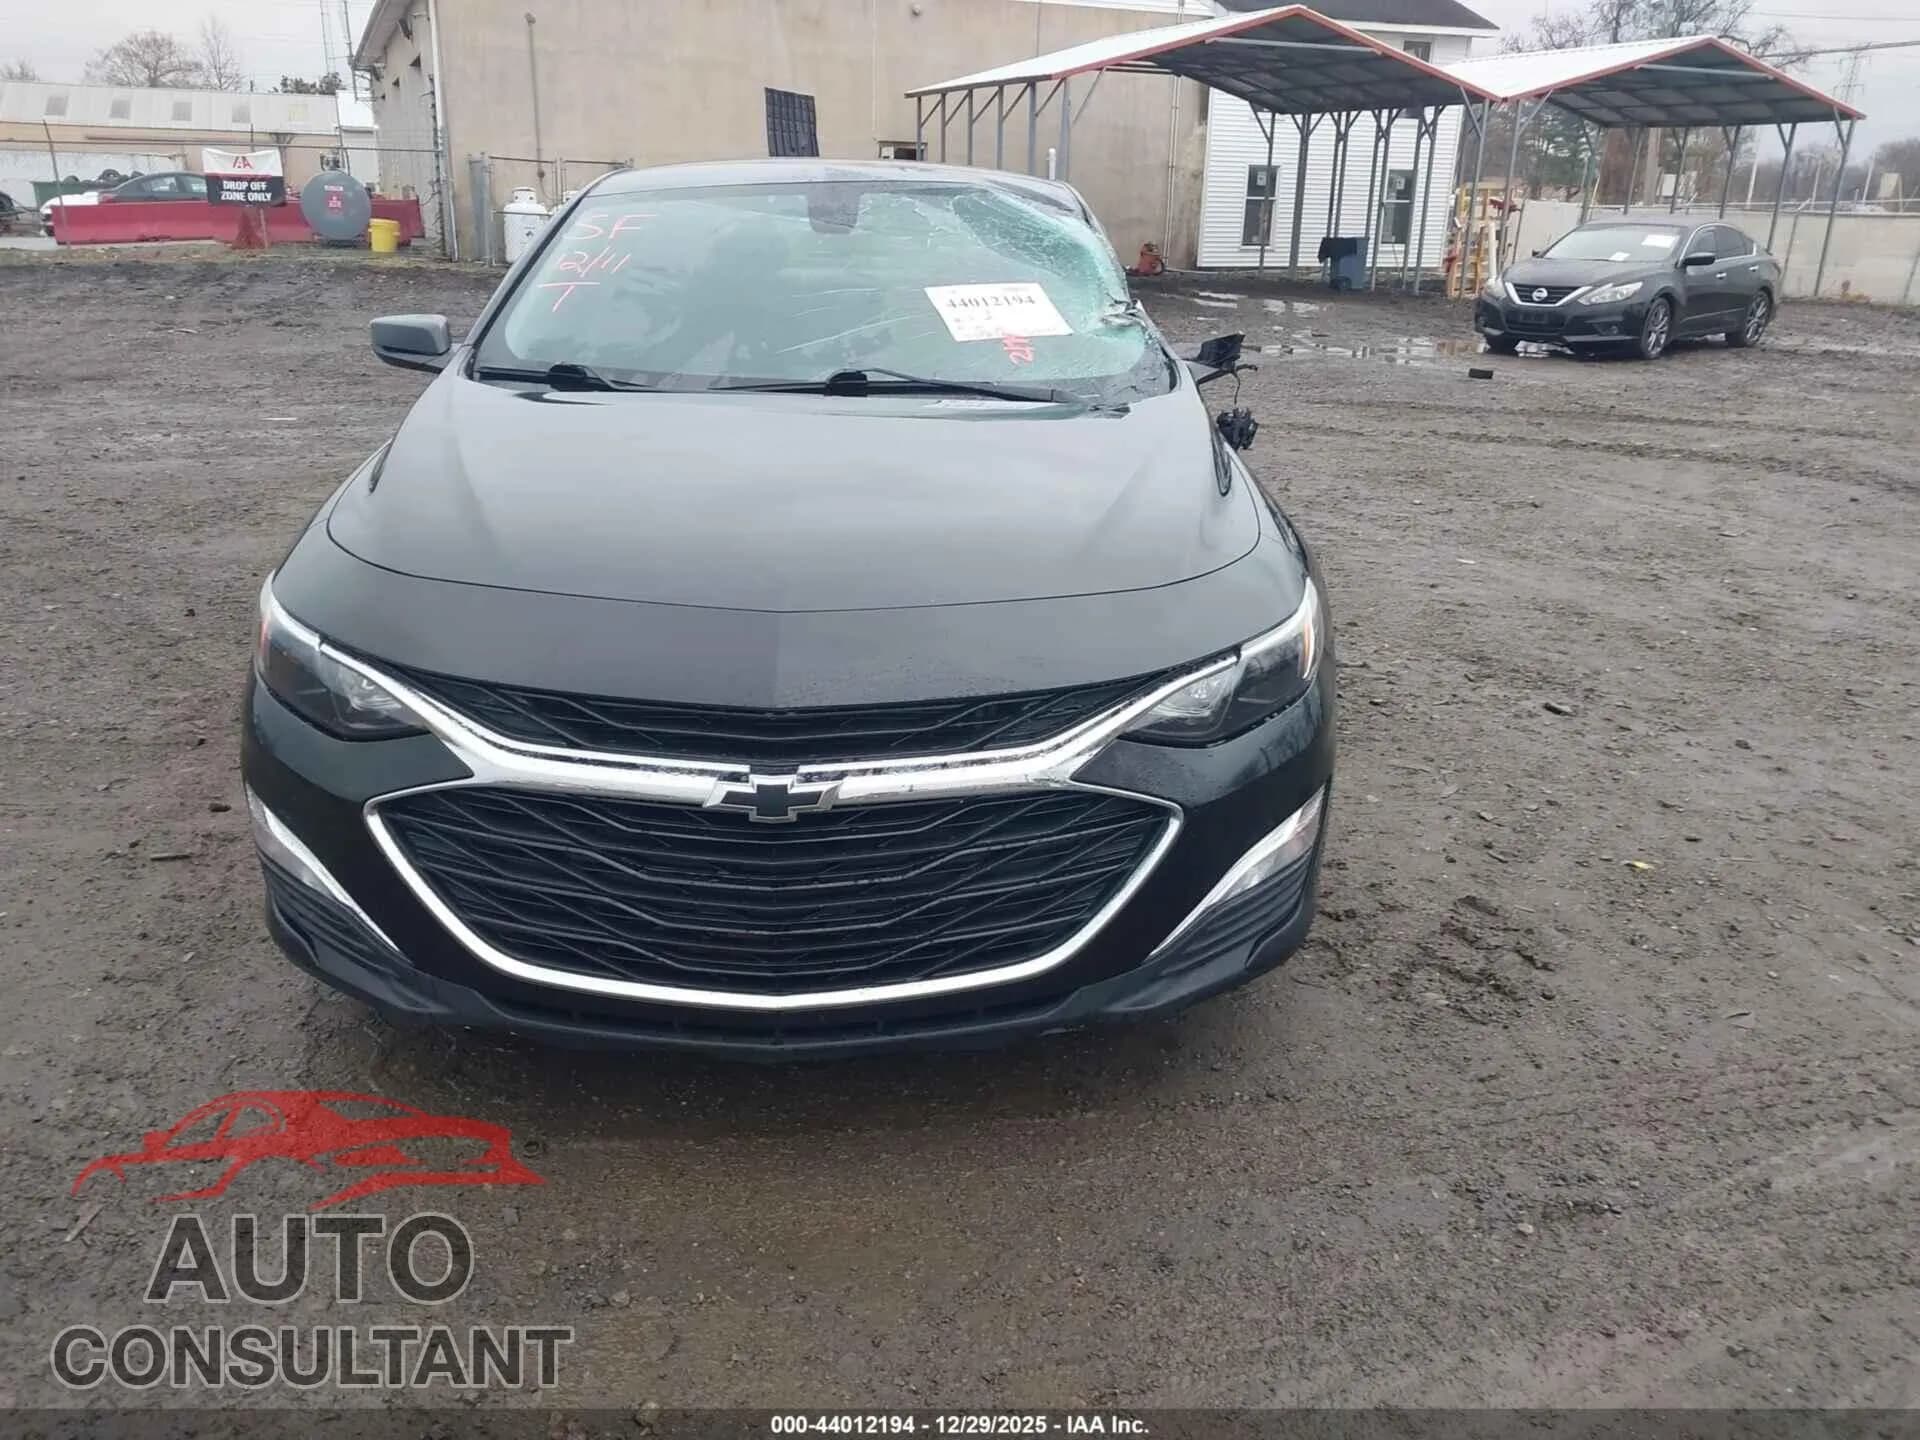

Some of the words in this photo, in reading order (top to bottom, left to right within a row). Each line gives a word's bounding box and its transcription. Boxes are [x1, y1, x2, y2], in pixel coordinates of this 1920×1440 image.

[223, 180, 249, 191] DROP
[250, 181, 268, 191] OFF
[220, 191, 246, 201] ZONE
[247, 191, 272, 202] ONLY
[946, 295, 1036, 309] 44012194
